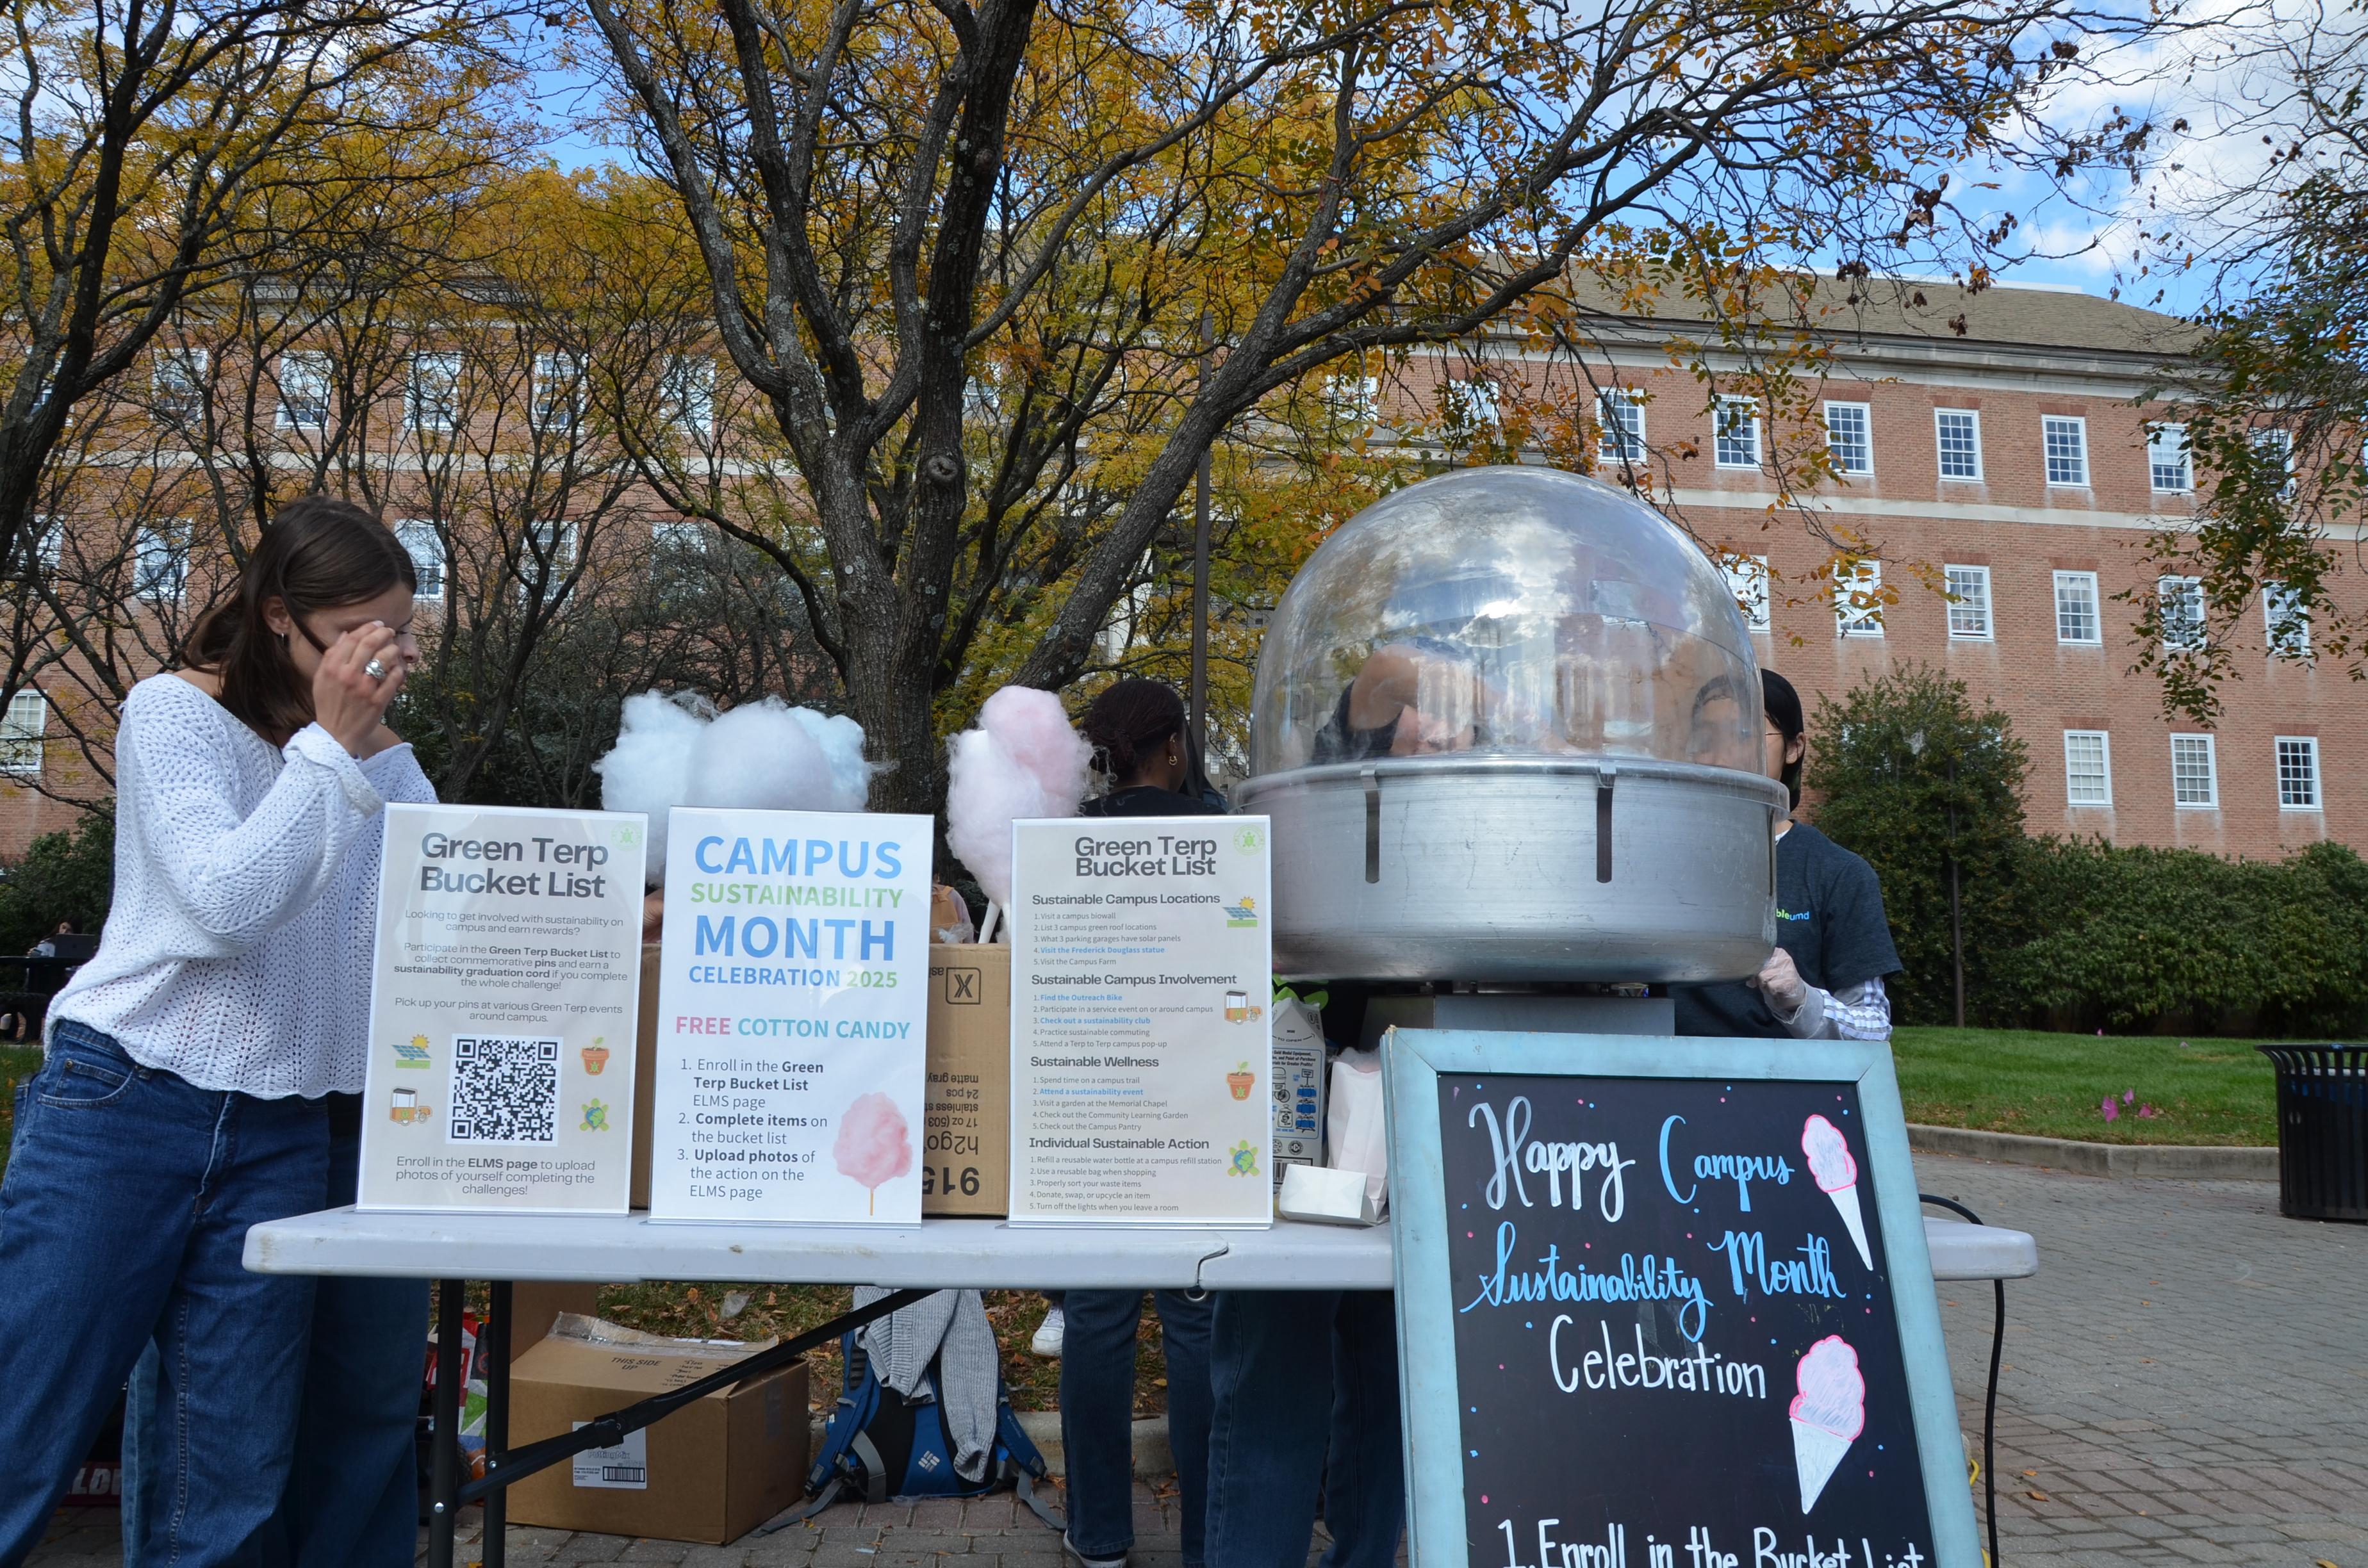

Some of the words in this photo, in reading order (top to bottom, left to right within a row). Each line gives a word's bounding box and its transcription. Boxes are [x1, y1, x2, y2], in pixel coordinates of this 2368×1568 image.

[422, 833, 523, 862] Green
[532, 837, 609, 871] Terp
[1075, 837, 1151, 856] Green
[1158, 836, 1217, 860] Terp
[695, 836, 901, 879] CAMPUS
[1076, 856, 1166, 877] Bucket
[1172, 856, 1216, 876] List
[420, 866, 540, 895] Bucket
[548, 872, 605, 898] List
[690, 883, 904, 908] SUSTAINABILITY
[1032, 894, 1103, 904] Sustainable
[1105, 894, 1158, 906] Campus
[1160, 894, 1221, 904] Locations
[406, 910, 445, 921] Looking
[459, 913, 476, 922] get
[478, 913, 520, 922] involved
[521, 915, 543, 923] with
[545, 917, 609, 927] sustainability
[445, 924, 486, 933] campus
[488, 924, 507, 933] and
[532, 927, 580, 935] rewards?
[695, 915, 894, 961] MONTH
[404, 942, 457, 952] Participate
[470, 945, 487, 954] the
[489, 945, 521, 954] Green
[523, 947, 548, 958] Terp
[550, 948, 588, 957] Bucket
[589, 949, 608, 958] List
[415, 954, 448, 963] collect
[450, 957, 532, 966] commemorative
[534, 959, 556, 968] pins
[558, 960, 577, 968] and
[394, 965, 464, 976] sustainability
[466, 968, 523, 977] graduation
[525, 969, 550, 977] cord
[560, 972, 579, 981] you
[580, 972, 627, 981] complete
[689, 966, 840, 986] CELEBRATION
[847, 971, 897, 988] 2025
[1032, 974, 1101, 984] Sustainable
[1104, 974, 1156, 986] Campus
[1158, 974, 1237, 984] Involvement
[461, 977, 477, 986] the
[479, 979, 509, 988] whole
[511, 980, 561, 991] challenge!
[395, 997, 416, 1006] Pick
[418, 1000, 432, 1008] up
[433, 1000, 456, 1009] your
[457, 1000, 479, 1009] pins
[493, 1002, 529, 1011] various
[530, 1002, 562, 1011] Green
[564, 1003, 588, 1014] Terp
[469, 1012, 505, 1020] around
[507, 1014, 548, 1023] campus.
[676, 1017, 731, 1034] FREE
[737, 1018, 828, 1037] COTTON
[835, 1021, 910, 1039] CANDY
[681, 1059, 691, 1070] 1.
[698, 1059, 736, 1071] Enroll
[741, 1059, 752, 1071] in
[756, 1059, 778, 1072] the
[782, 1061, 823, 1073] Green
[1030, 1056, 1101, 1066] Sustainable
[1104, 1056, 1159, 1066] Wellness
[693, 1077, 726, 1091] Terp
[730, 1077, 779, 1090] Bucket
[783, 1078, 809, 1090] List
[927, 1072, 949, 1082] gray
[951, 1075, 979, 1084] matte
[946, 1087, 964, 1097] pcs
[966, 1089, 978, 1099] 24
[693, 1095, 729, 1107] ELMS
[733, 1098, 766, 1111] page
[935, 1103, 978, 1113] stainless
[678, 1112, 689, 1123] 2.
[695, 1113, 764, 1127] Complete
[768, 1114, 807, 1126] items
[810, 1118, 827, 1127] on
[928, 1115, 950, 1128] (503
[951, 1117, 964, 1125] oz
[966, 1117, 978, 1127] 17
[691, 1130, 713, 1143] the
[717, 1131, 763, 1143] bucket
[767, 1131, 787, 1144] list
[1029, 1138, 1090, 1148] Individual
[1092, 1138, 1165, 1148] Sustainable
[1167, 1138, 1209, 1149] Action
[677, 1148, 688, 1160] 3.
[695, 1149, 744, 1163] Upload
[749, 1150, 798, 1164] photos
[802, 1150, 815, 1163] of
[1469, 1096, 1635, 1222] Happy
[1659, 1115, 1795, 1212] Campus
[397, 1156, 430, 1166] Enroll
[432, 1157, 443, 1166] in
[445, 1157, 465, 1168] the
[468, 1158, 504, 1168] ELMS
[506, 1161, 538, 1171] page
[540, 1161, 552, 1170] to
[555, 1160, 595, 1172] upload
[395, 1169, 438, 1180] photos
[441, 1170, 454, 1180] of
[456, 1171, 504, 1182] yourself
[506, 1173, 572, 1185] completing
[575, 1173, 595, 1183] the
[690, 1166, 712, 1179] the
[716, 1168, 757, 1179] action
[761, 1171, 778, 1180] on
[782, 1168, 804, 1180] the
[462, 1184, 527, 1197] challenges!
[690, 1185, 726, 1197] ELMS
[730, 1188, 762, 1201] page
[1459, 1221, 1714, 1343] Sustainability
[1707, 1230, 1846, 1298] Month
[1550, 1314, 1766, 1398] Celebration
